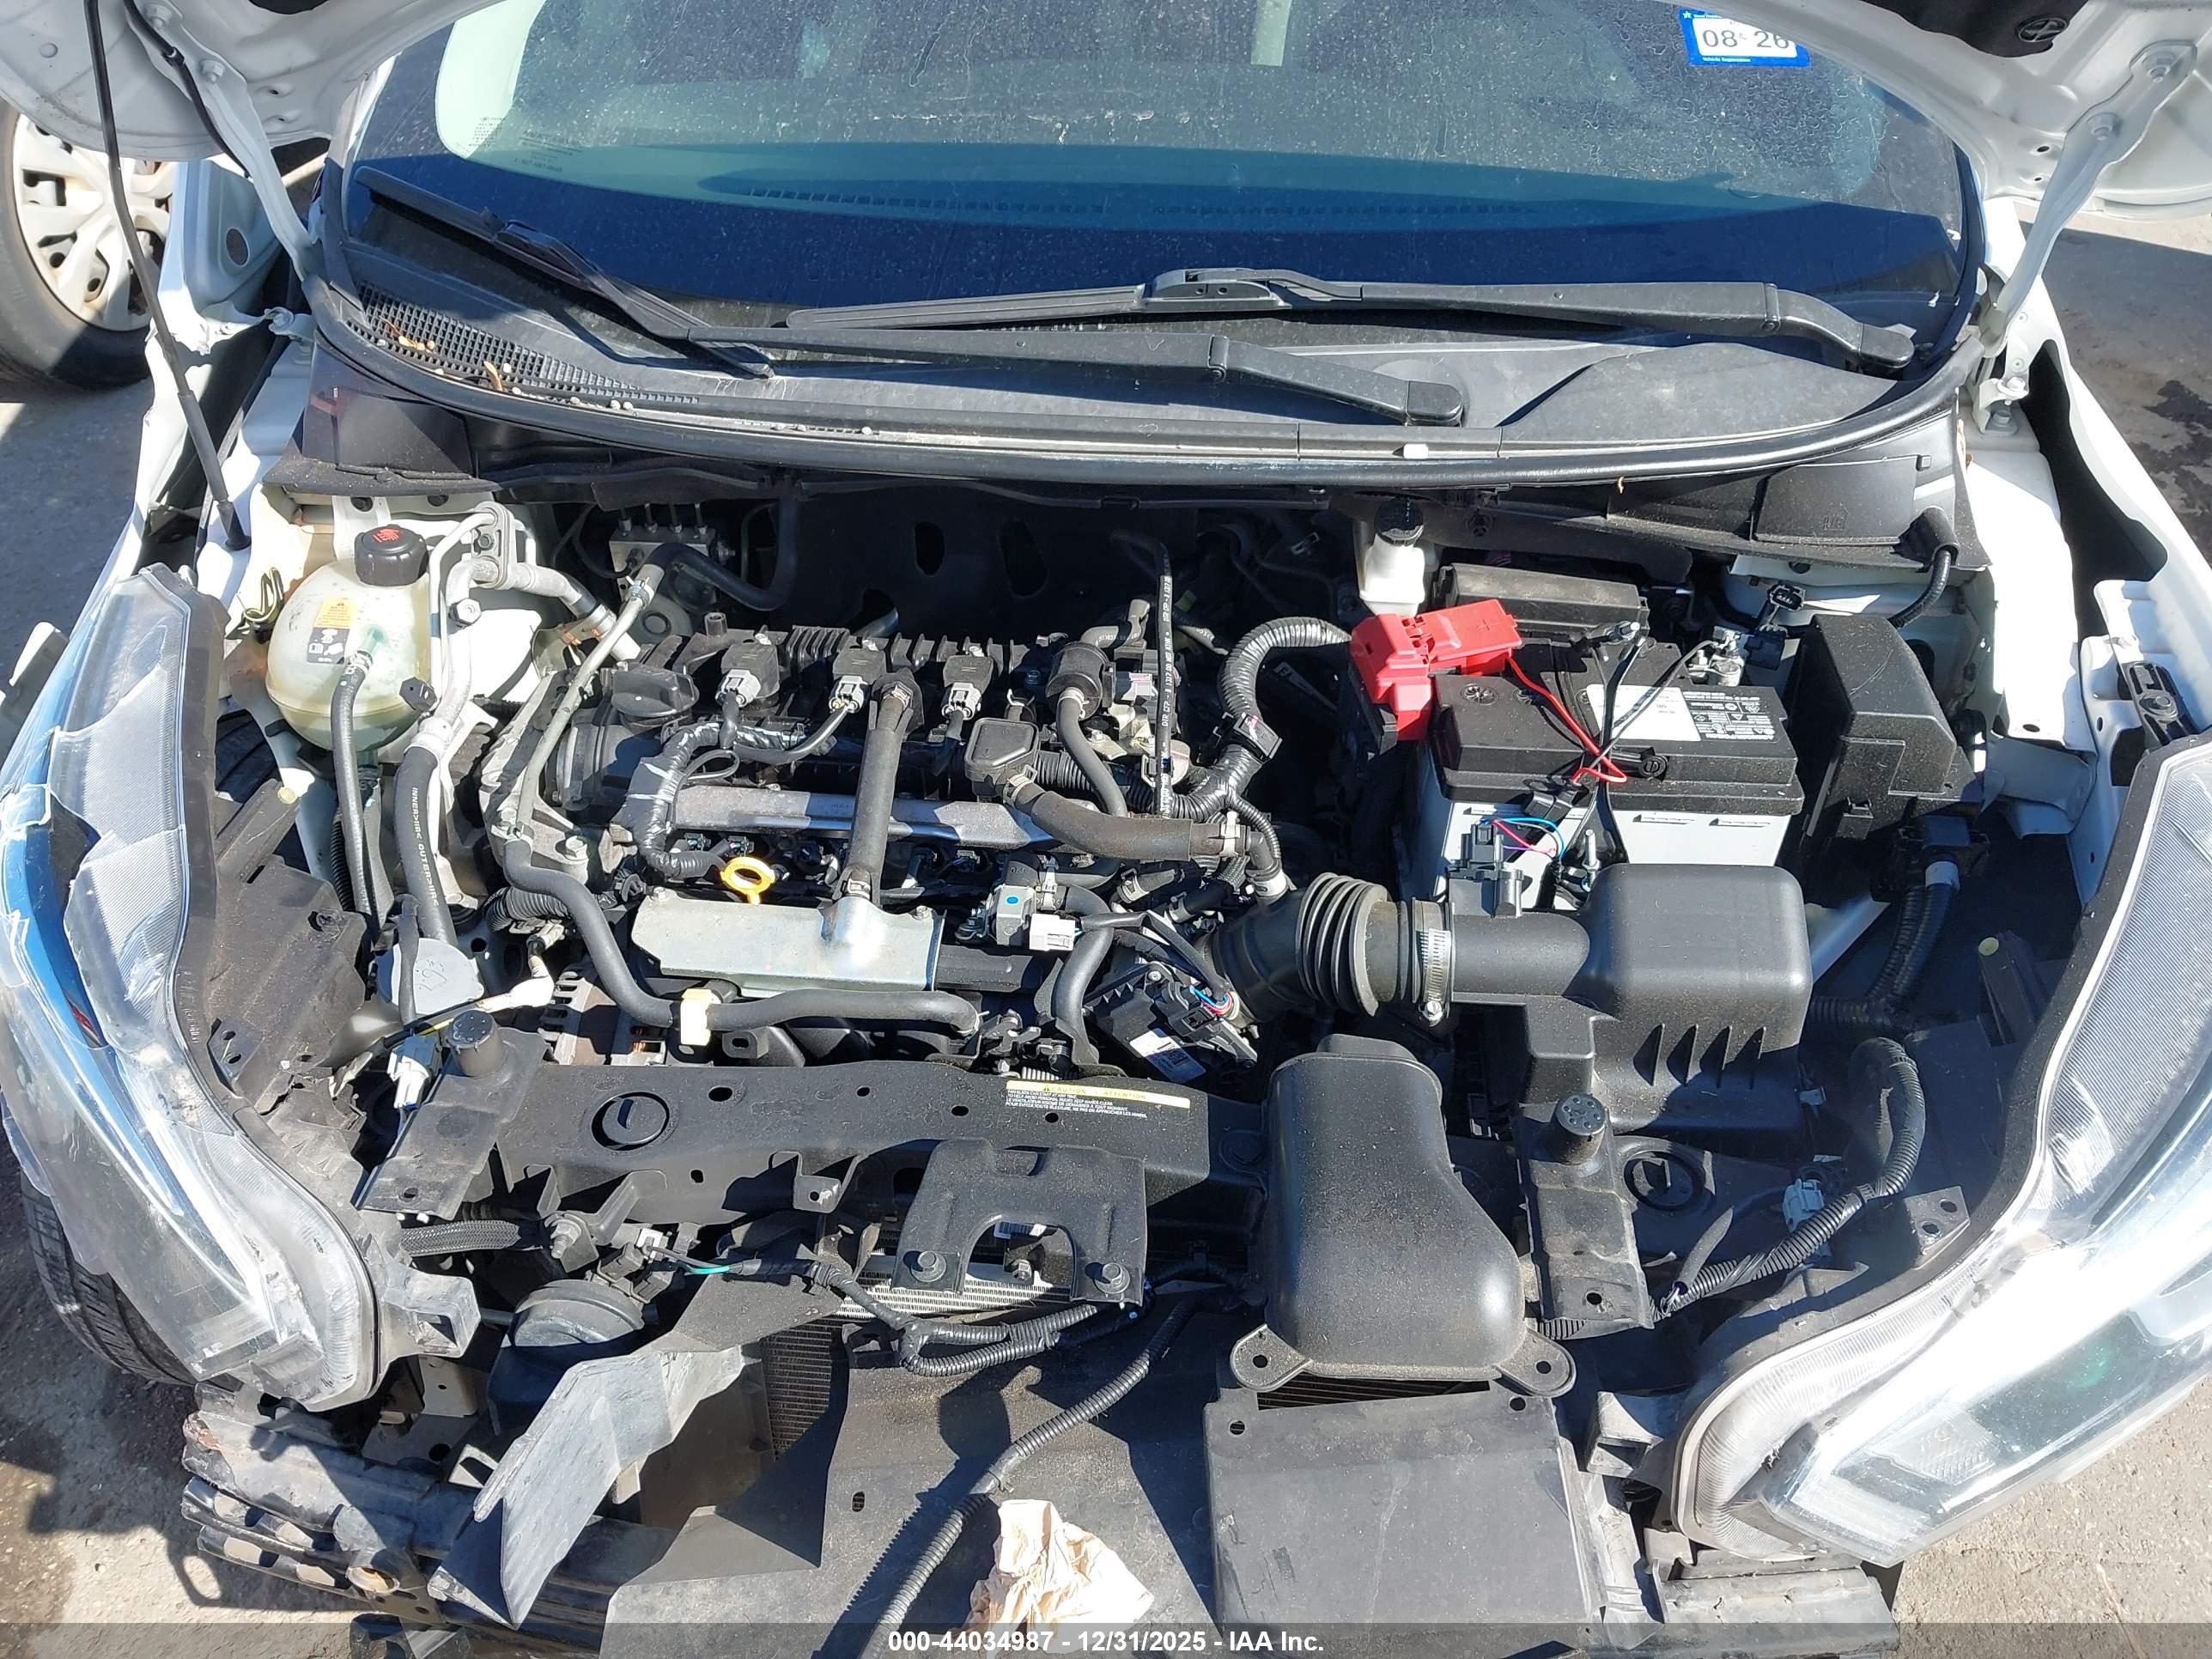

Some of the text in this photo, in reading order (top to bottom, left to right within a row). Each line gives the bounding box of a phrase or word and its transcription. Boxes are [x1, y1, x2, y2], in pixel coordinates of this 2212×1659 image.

[1702, 29, 1790, 49] 08 26
[1103, 1091, 1146, 1099] ATTENTION
